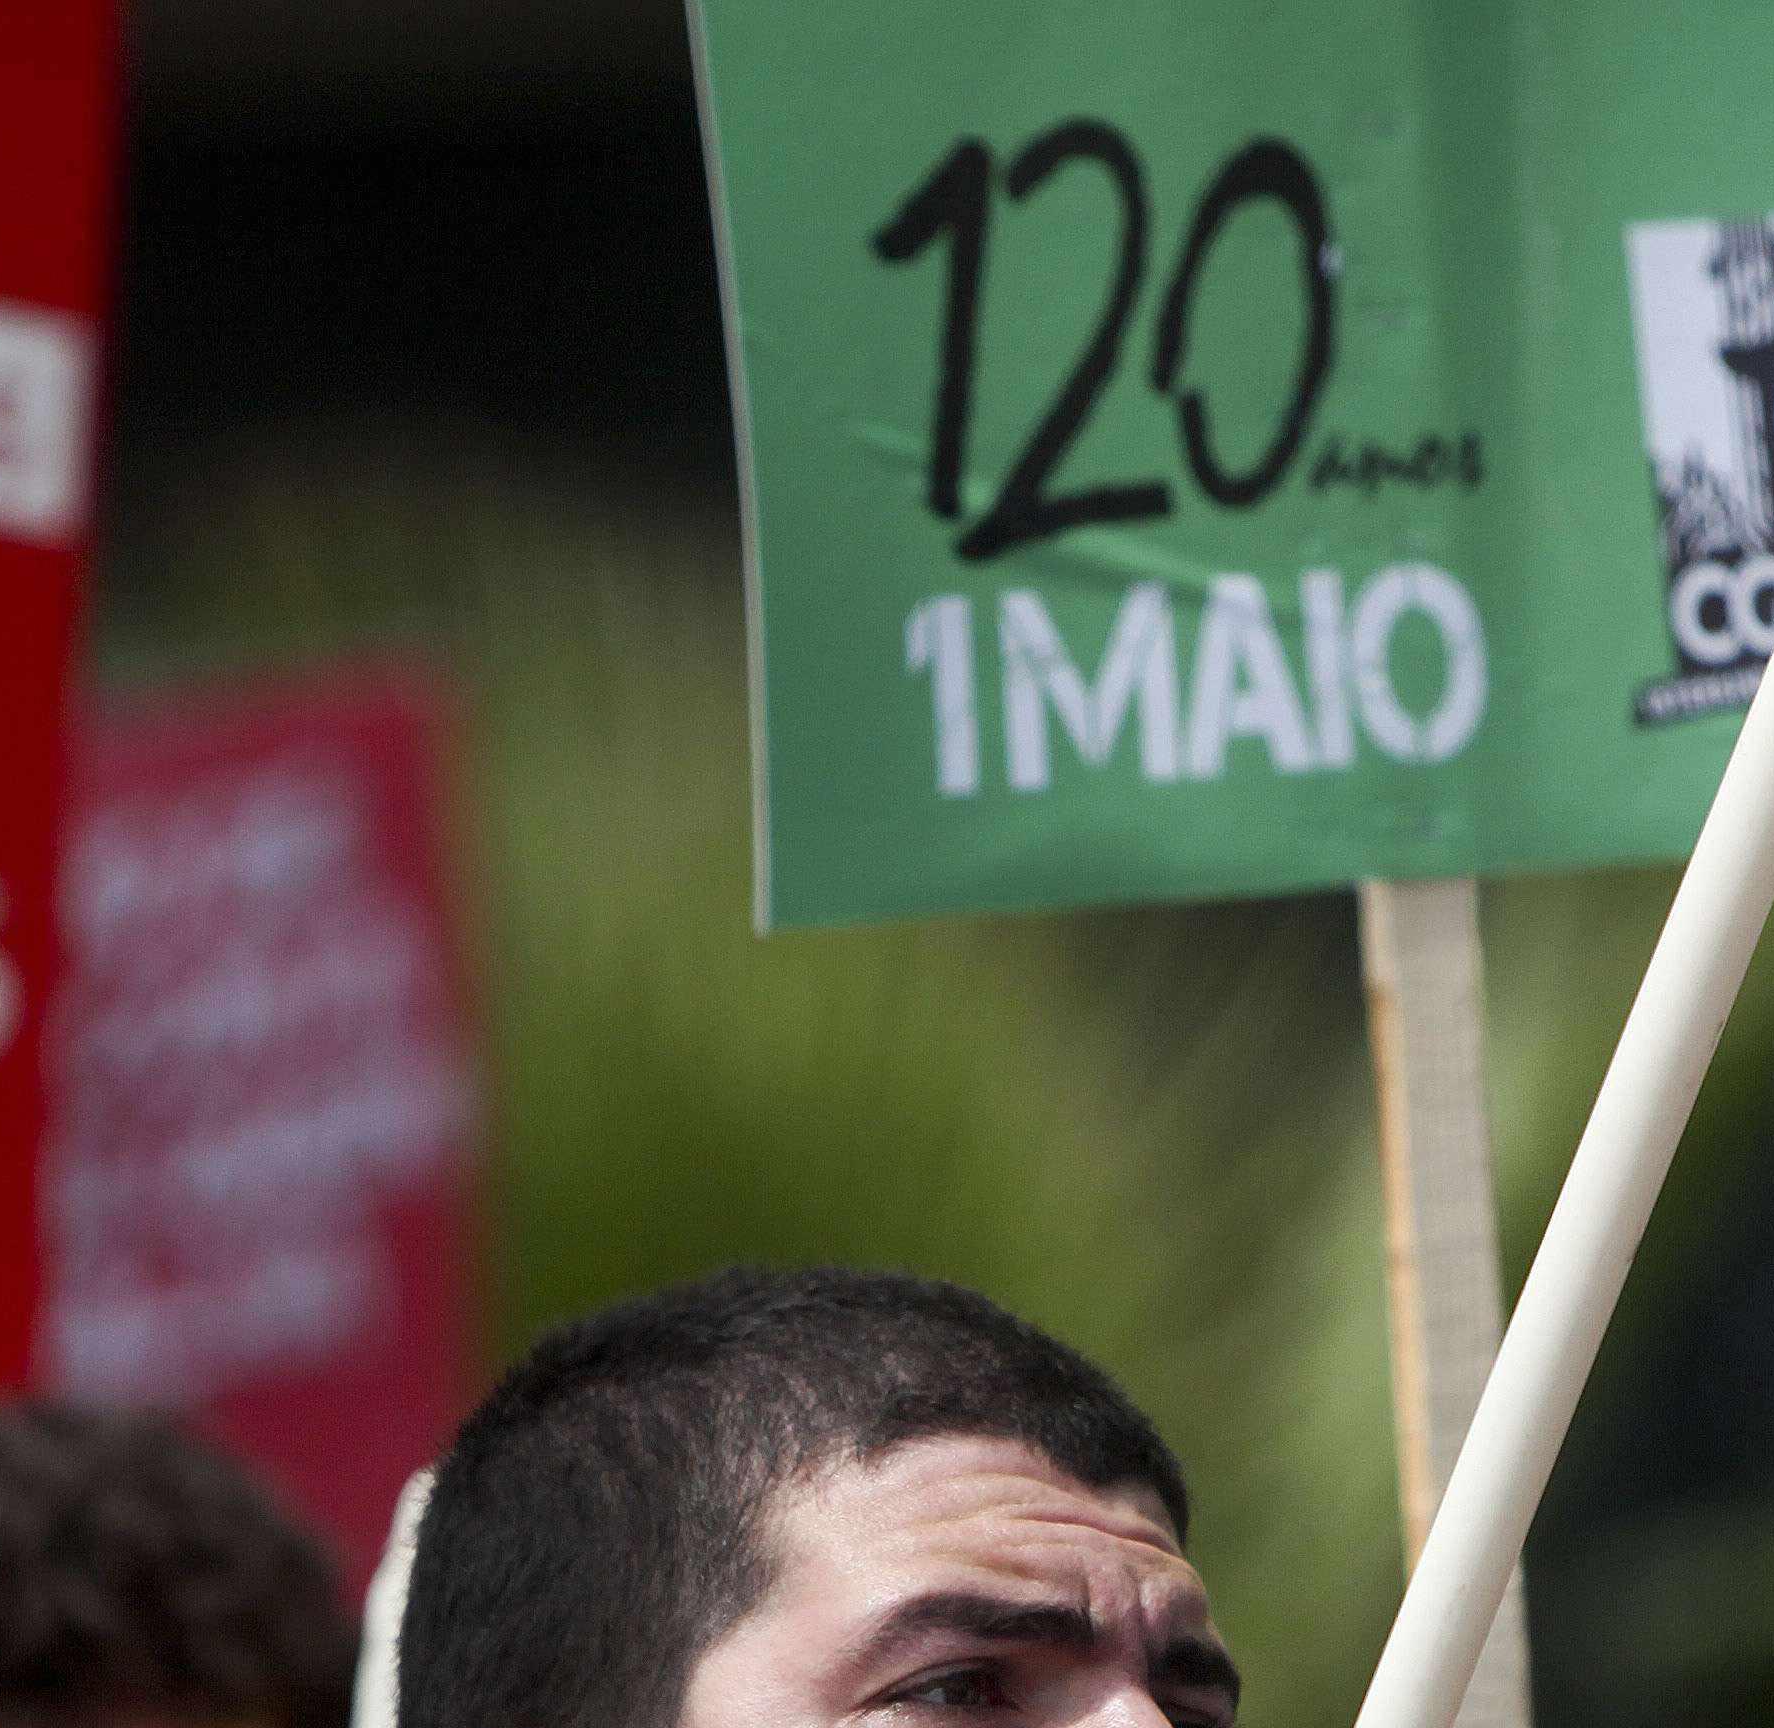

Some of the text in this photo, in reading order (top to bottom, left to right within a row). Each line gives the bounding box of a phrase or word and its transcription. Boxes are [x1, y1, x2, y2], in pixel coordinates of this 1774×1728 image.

[870, 116, 1342, 564] 120
[904, 562, 1488, 798] 1 MAIO
